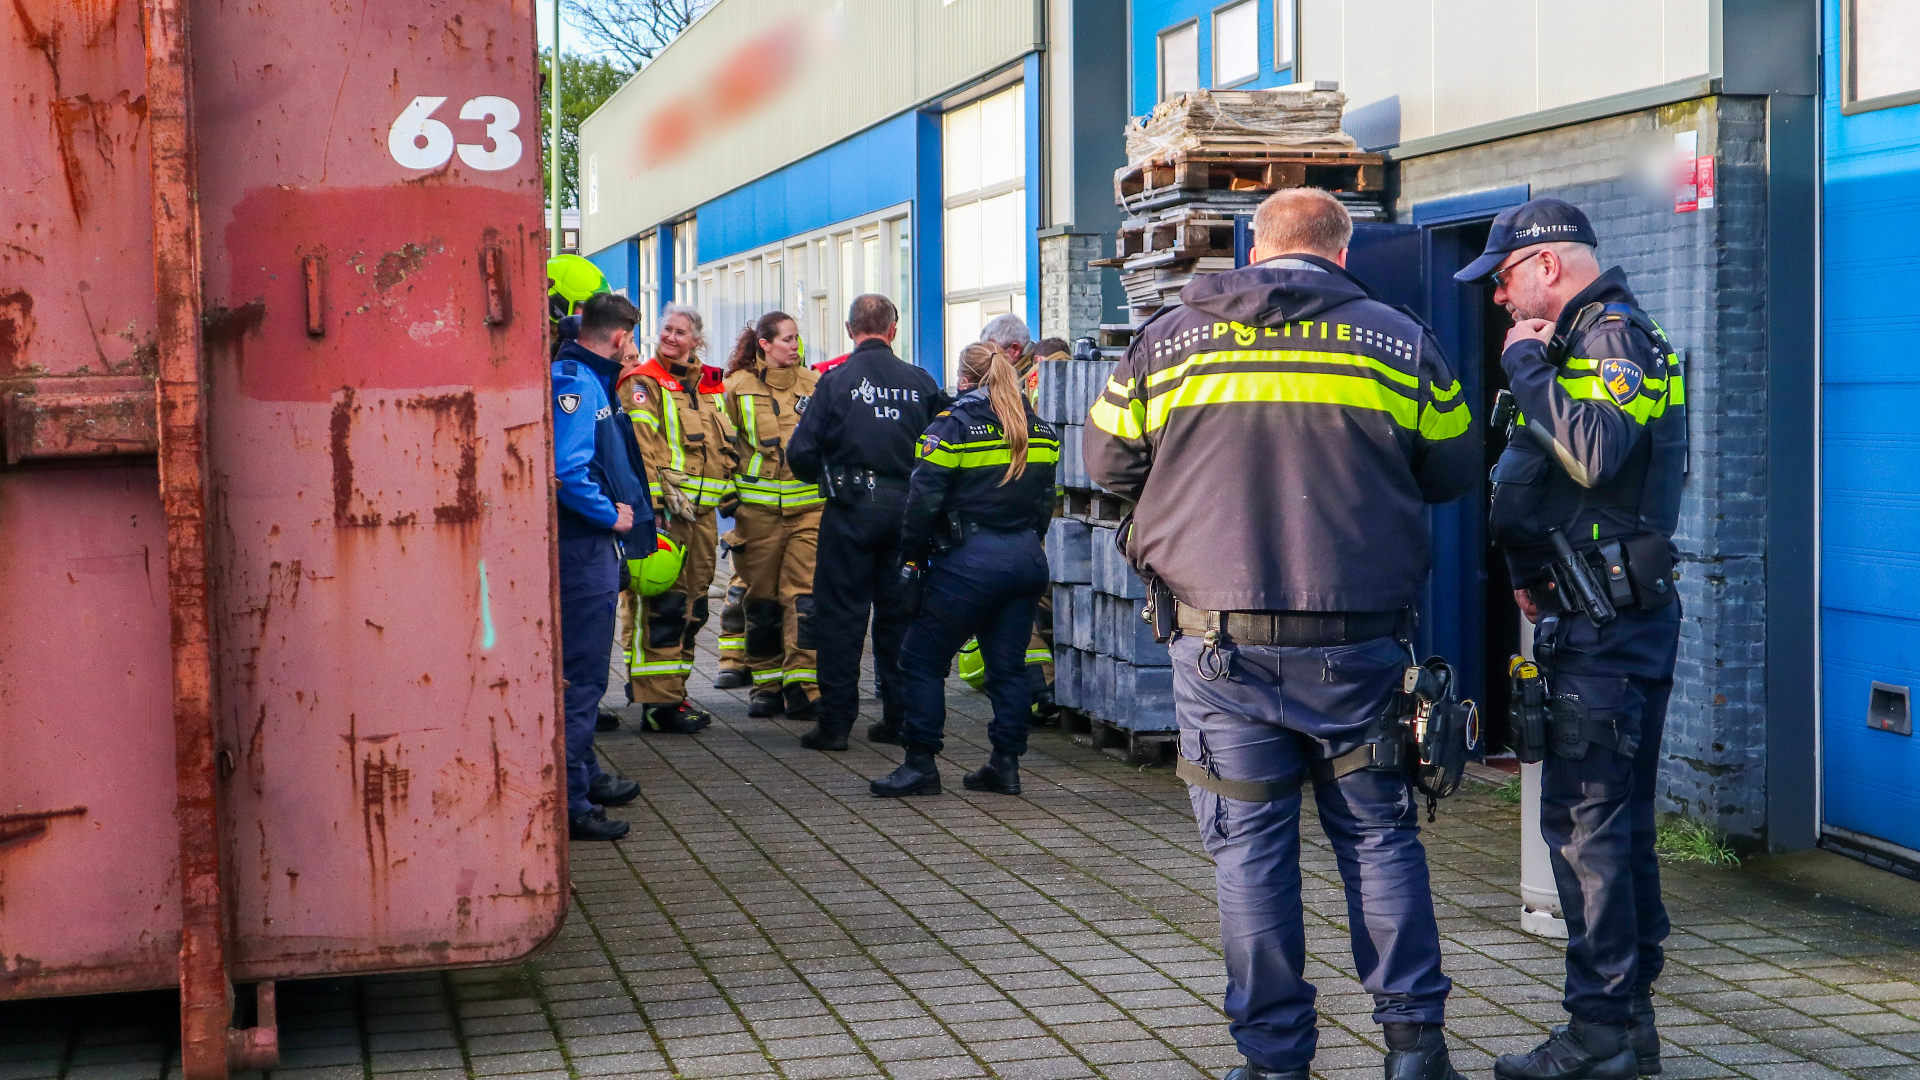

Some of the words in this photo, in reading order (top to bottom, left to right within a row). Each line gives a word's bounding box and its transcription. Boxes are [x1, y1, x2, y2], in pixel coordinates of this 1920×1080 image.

[387, 95, 523, 171] 63
[1526, 222, 1568, 237] POLITIE
[1212, 320, 1351, 346] POLITIE
[1605, 361, 1639, 378] POLITIE
[850, 376, 919, 404] POLITIE
